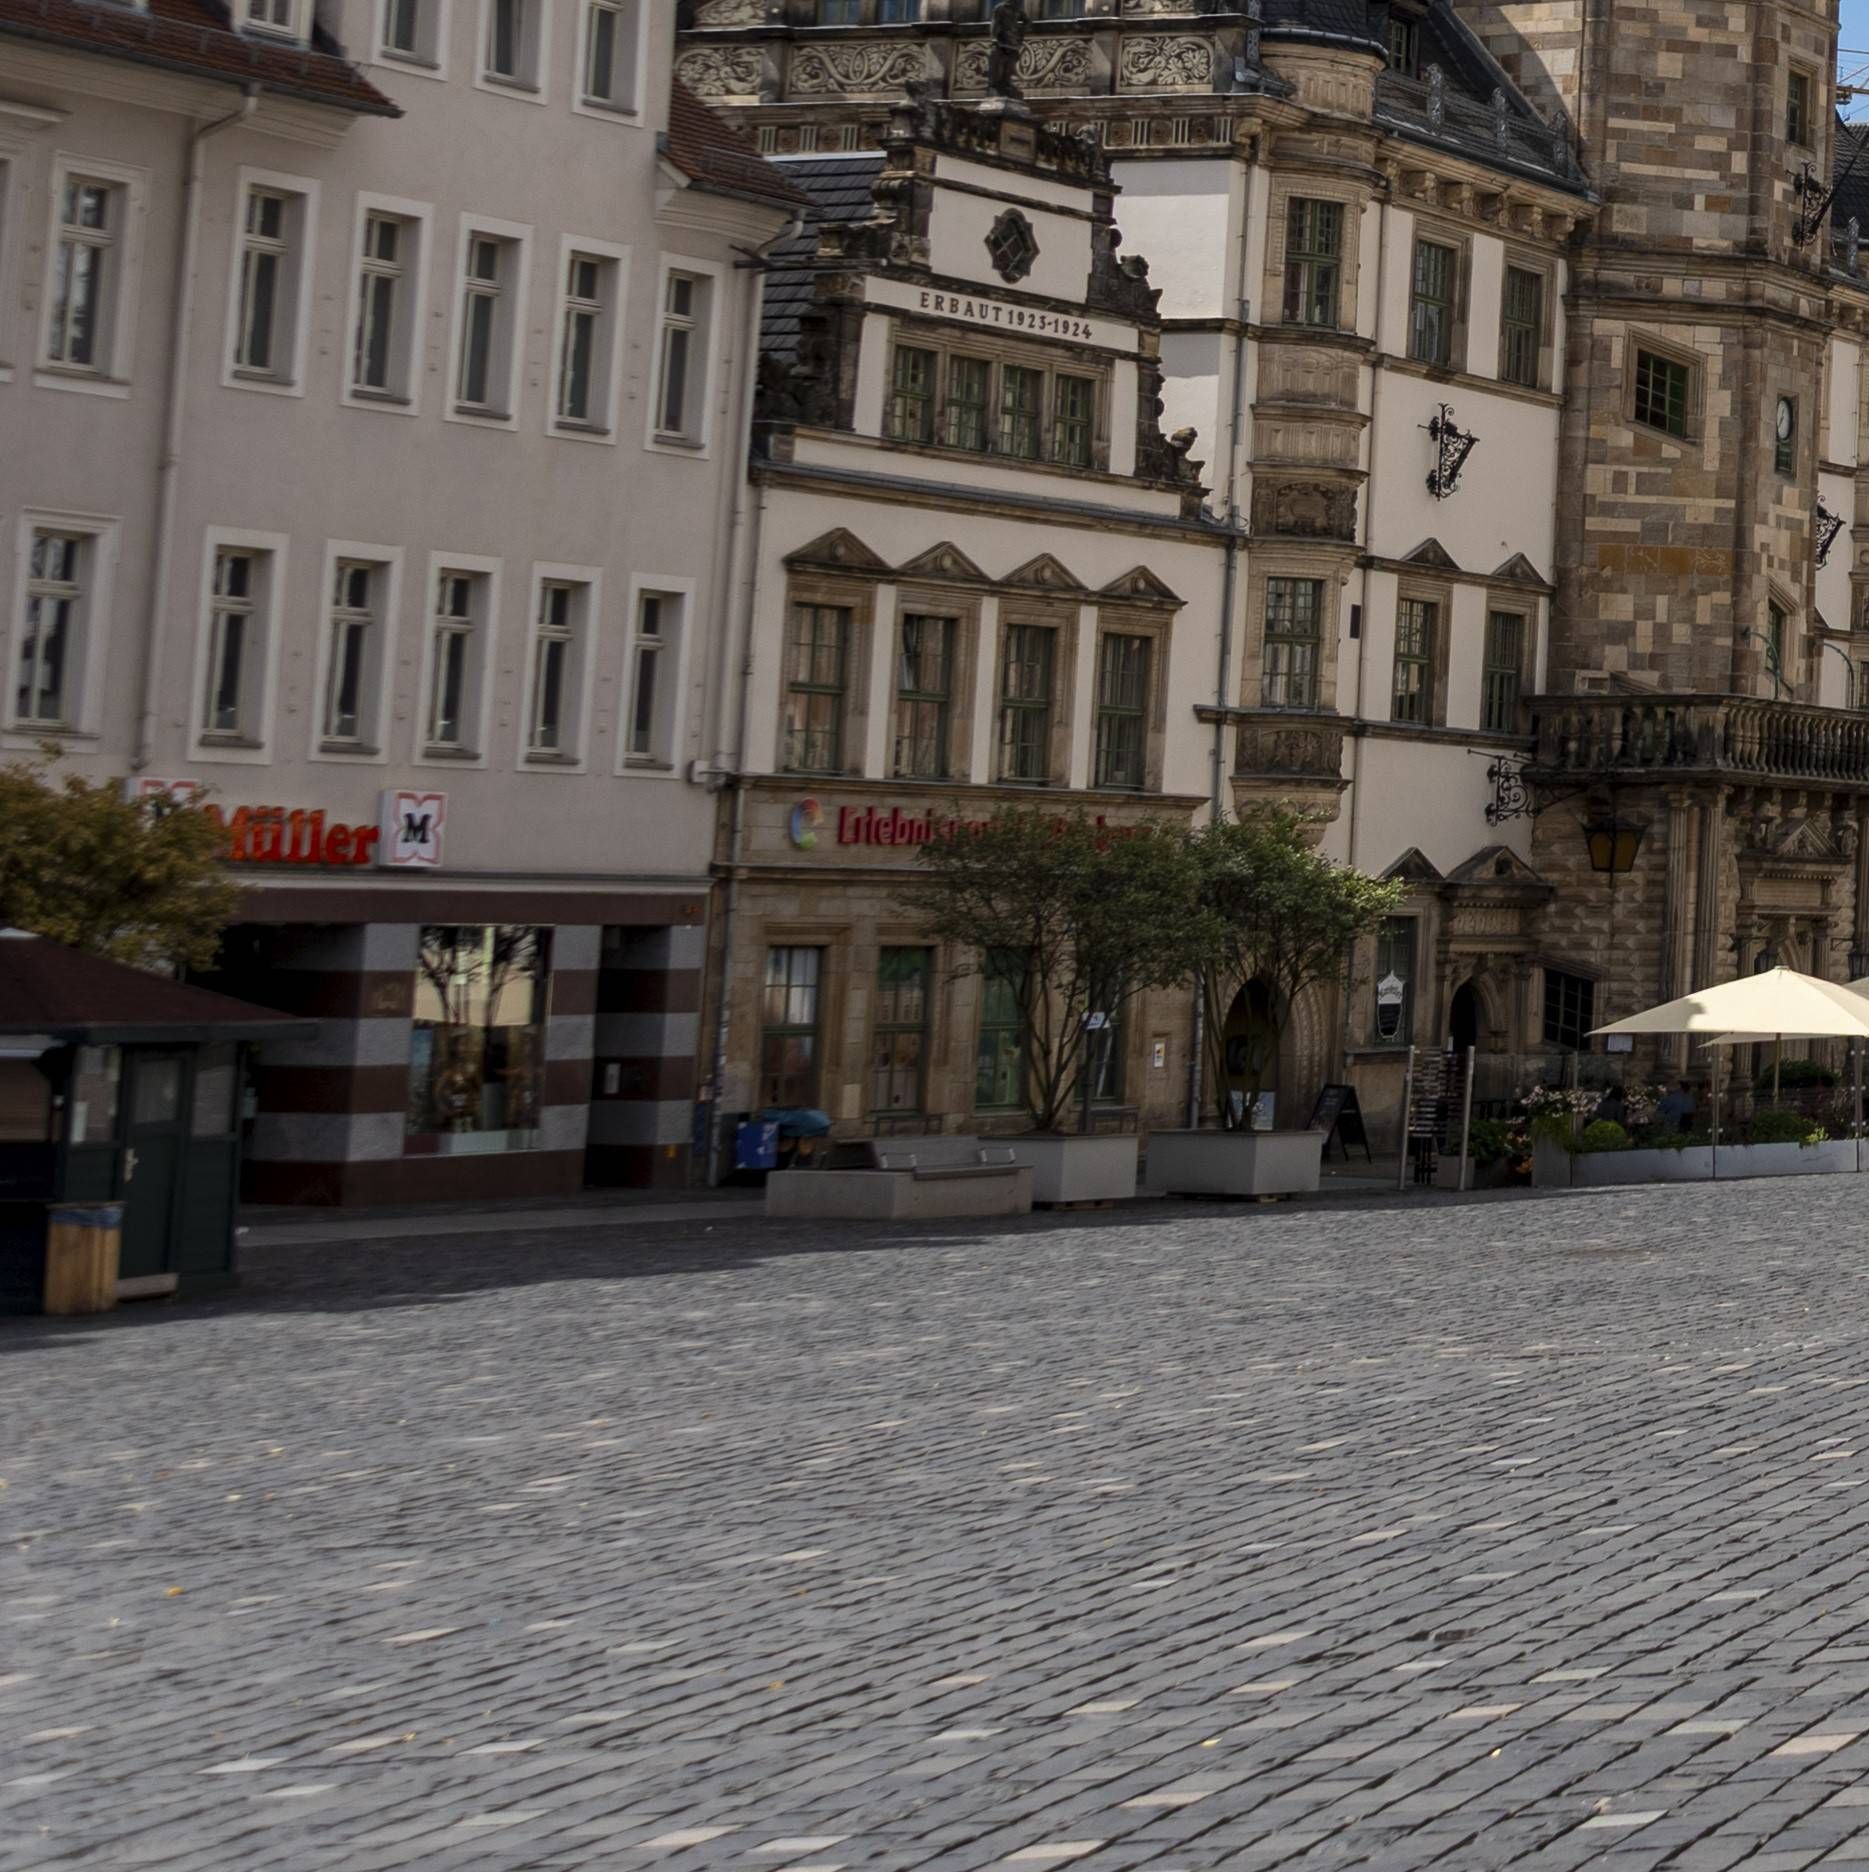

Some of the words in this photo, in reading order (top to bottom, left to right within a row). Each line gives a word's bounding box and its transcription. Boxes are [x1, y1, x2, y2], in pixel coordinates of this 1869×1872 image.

[920, 292, 1002, 322] ERBAUT
[1007, 309, 1092, 340] 1923-1924
[203, 804, 381, 865] Müller
